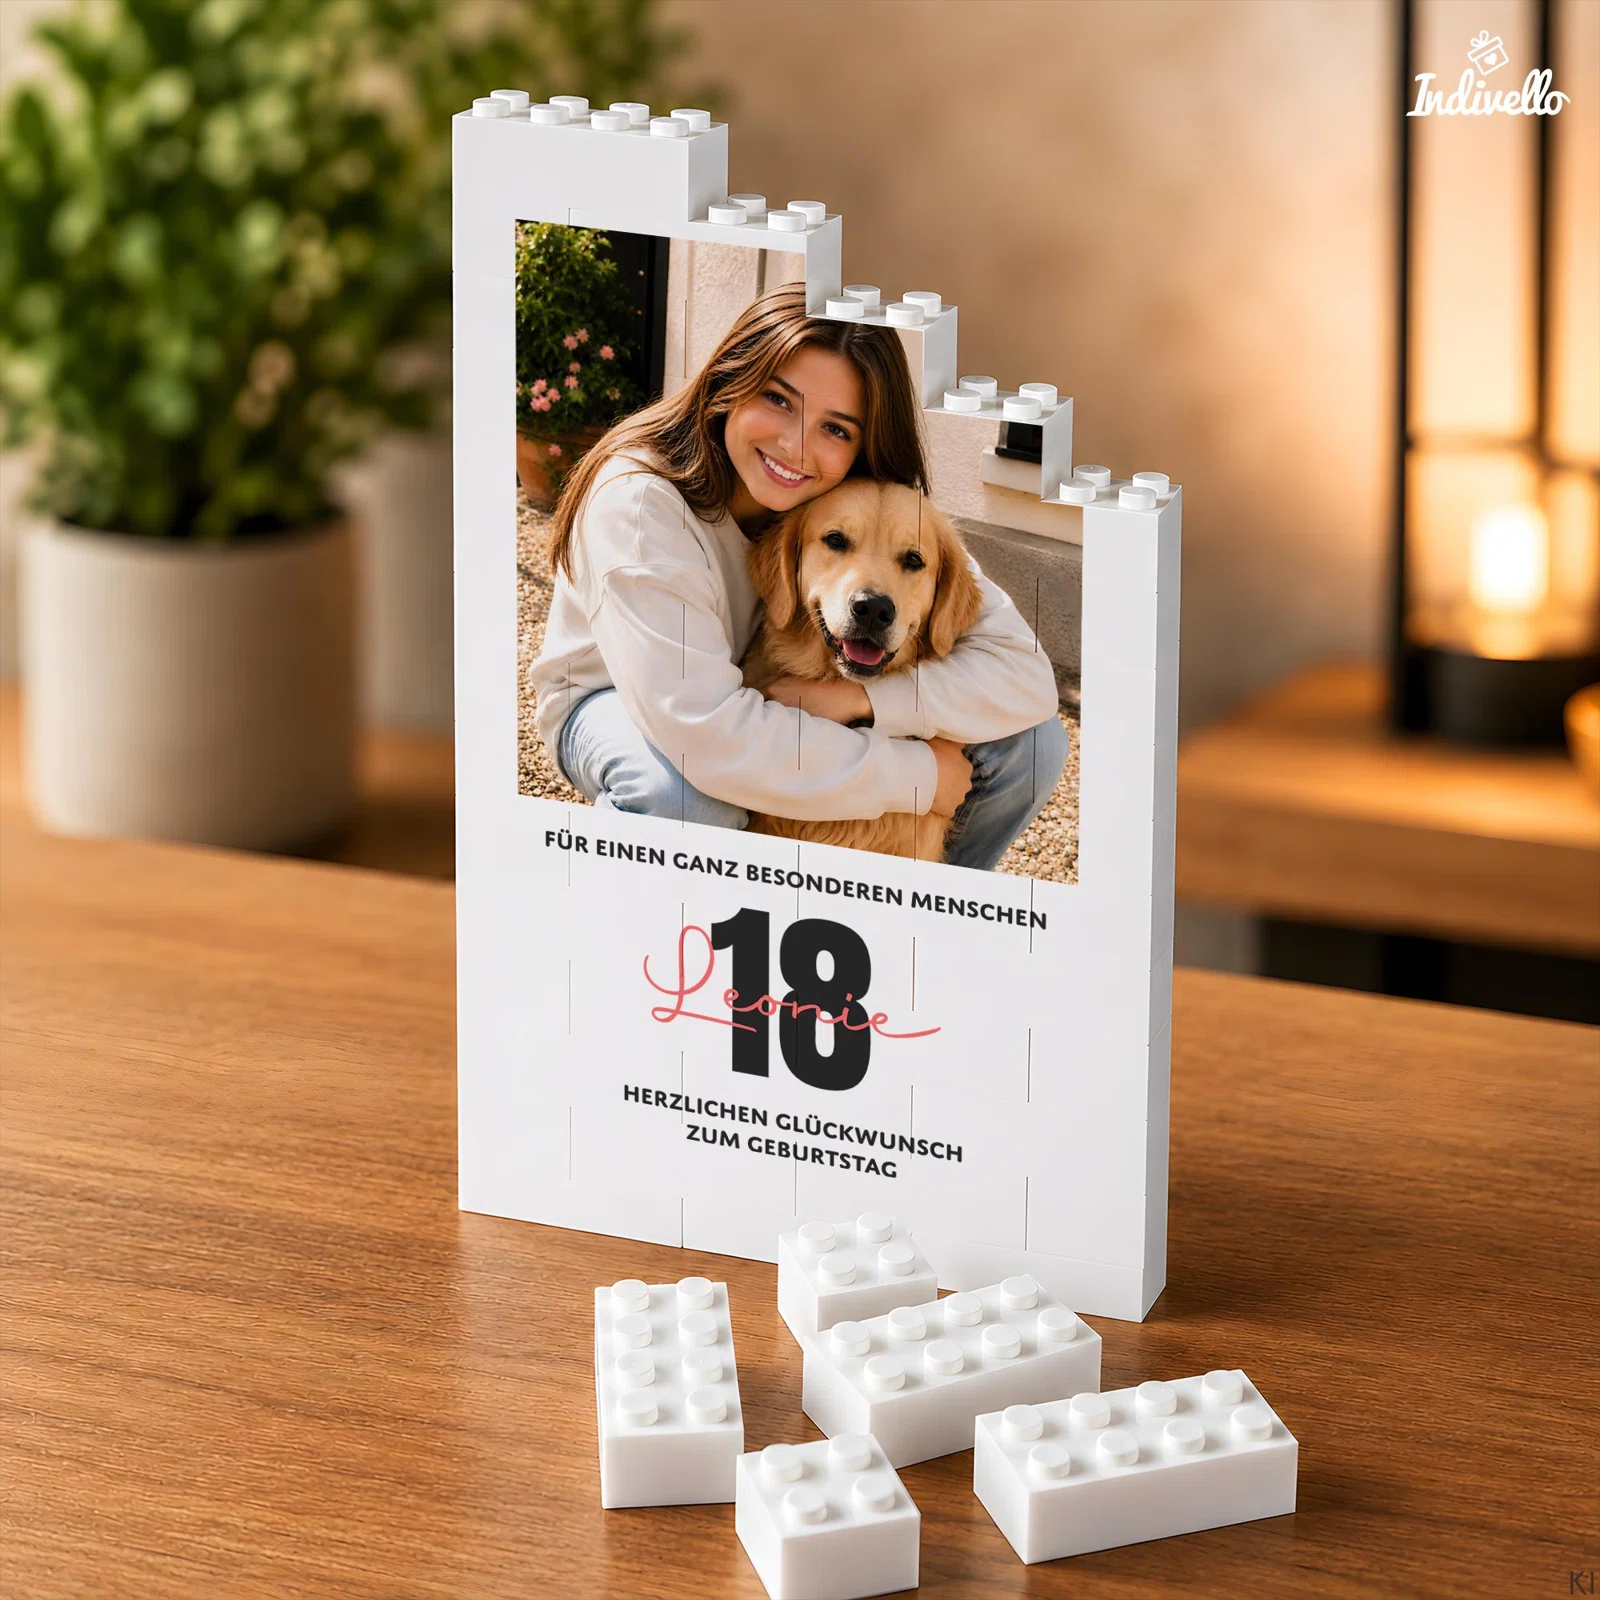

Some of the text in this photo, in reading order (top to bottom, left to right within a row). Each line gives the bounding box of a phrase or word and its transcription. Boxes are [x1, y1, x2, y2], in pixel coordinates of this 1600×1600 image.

[544, 828, 1048, 931] FÜR EINEN GANZ BESONDEREN MENSCHEN
[643, 924, 942, 1039] Leonie
[710, 906, 872, 1092] 18
[623, 1083, 963, 1164] HERZLICHEN GLÜCKWUNSCH
[685, 1123, 898, 1179] ZUM GEBURTSTAG
